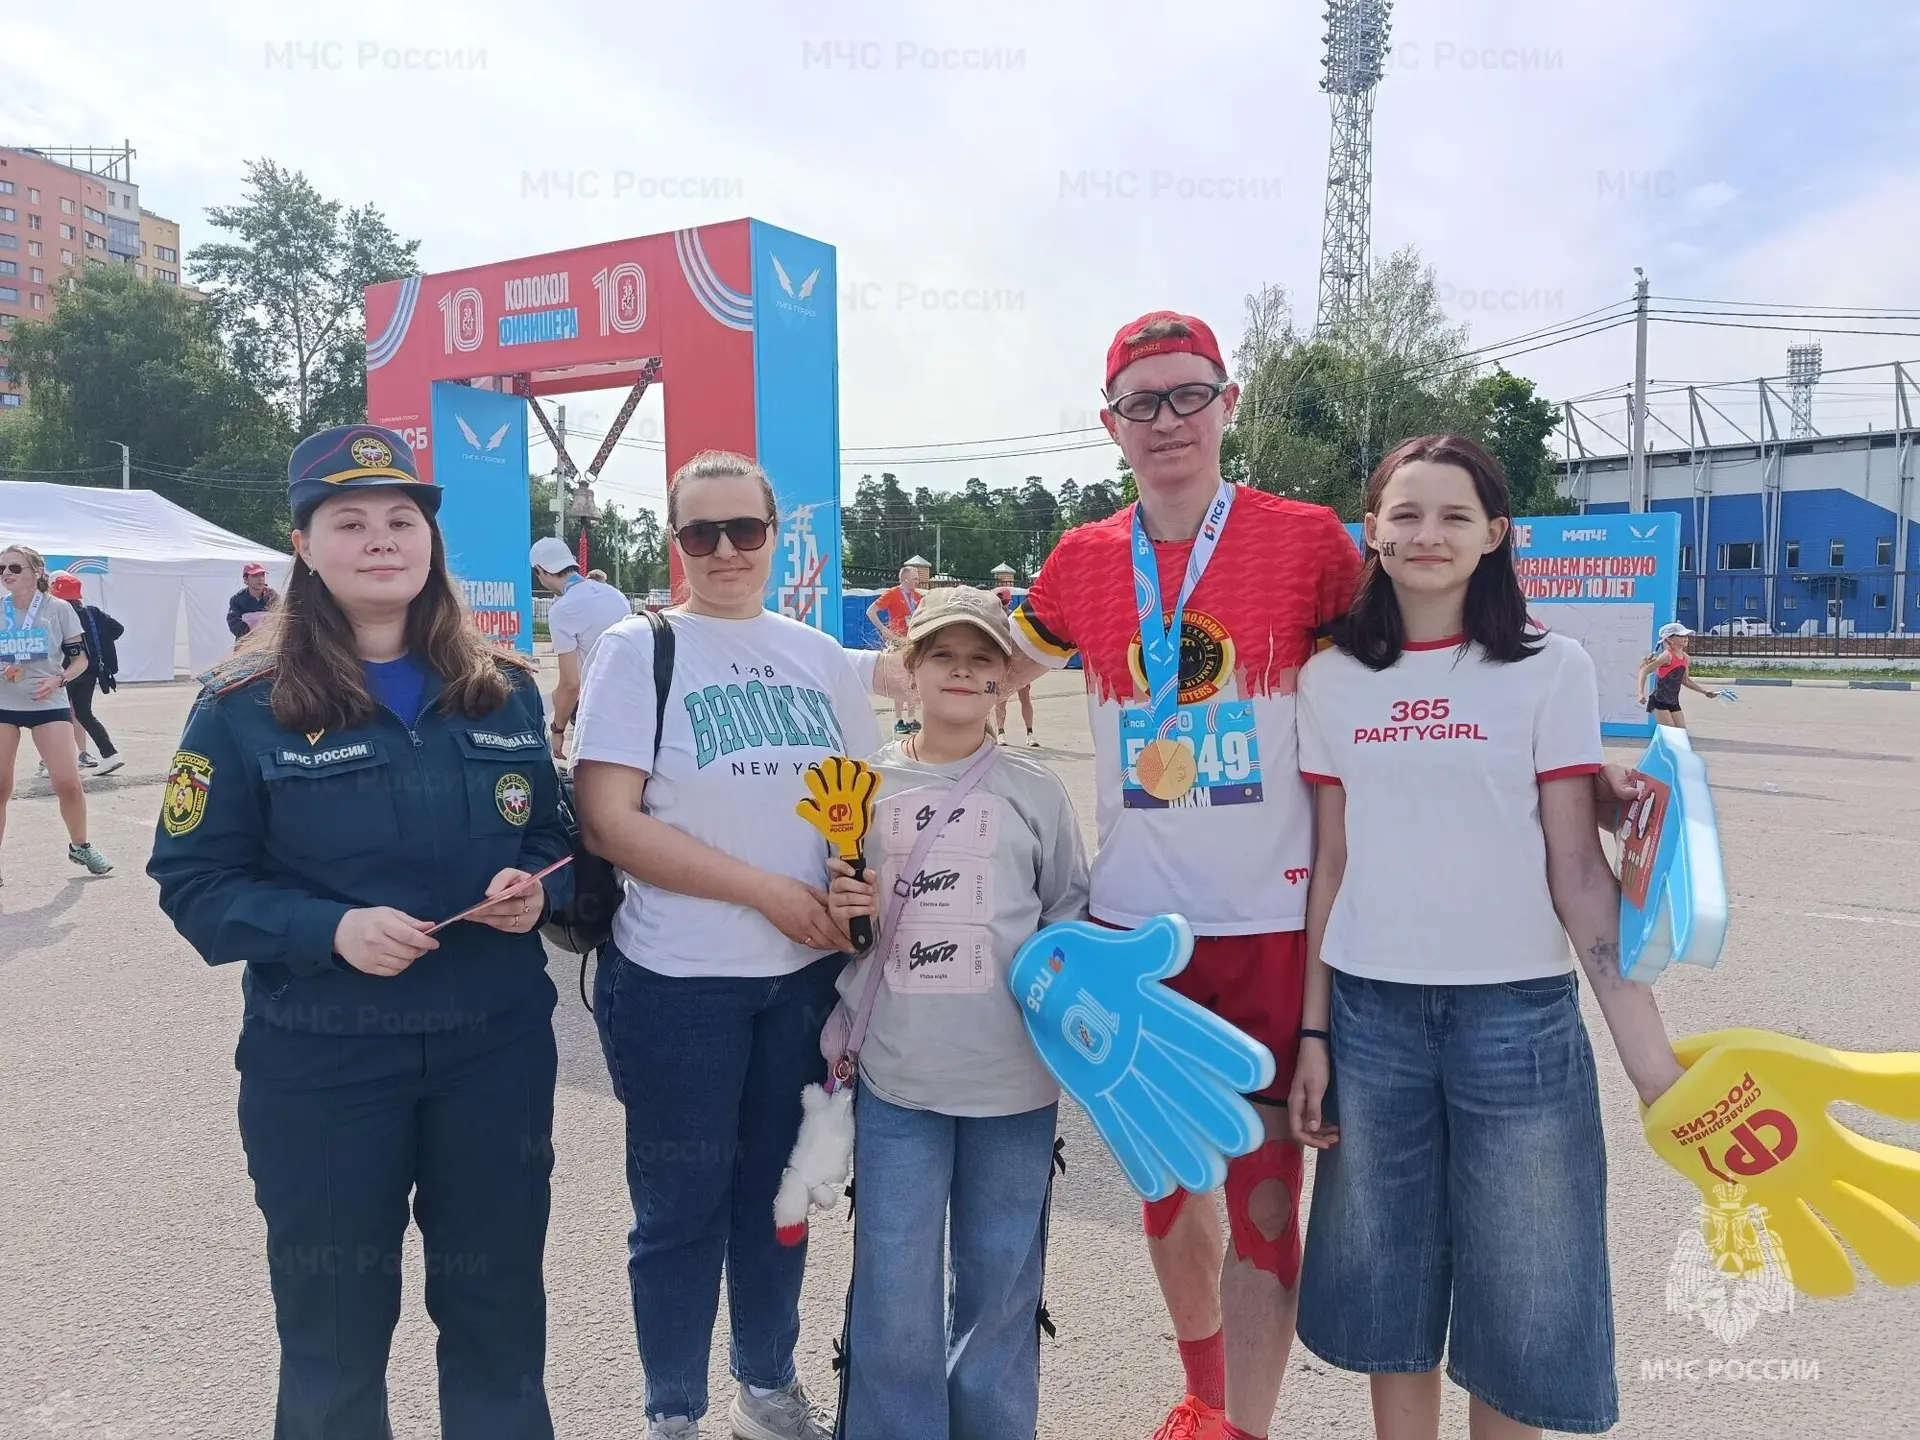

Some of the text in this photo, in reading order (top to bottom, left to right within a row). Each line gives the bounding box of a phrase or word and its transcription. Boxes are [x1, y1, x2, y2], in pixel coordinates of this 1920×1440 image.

[505, 272, 569, 311] КОЛОКОЛ
[592, 262, 646, 337] 10
[438, 287, 484, 355] 10
[500, 308, 578, 345] ФИНИШЕРА
[1209, 499, 1226, 525] ПСБ
[1137, 530, 1149, 556] ПСБ
[1562, 529, 1607, 542] МАТЧ!
[784, 533, 822, 587] ЗА
[1584, 556, 1657, 577] БЕГОВУЮ
[1519, 577, 1635, 599] УЛЬТУРУ 10 ЛЕТ
[472, 611, 520, 636] КОРДЫ
[1182, 611, 1225, 640] MOSCOW
[1390, 698, 1450, 723] 365
[1354, 723, 1489, 744] PARTYGIRL
[282, 744, 368, 765] МЧС РОССИИ
[732, 762, 779, 776] NEW
[1126, 731, 1251, 786] 549
[979, 810, 989, 837] 199119
[975, 875, 983, 905] 199119
[974, 944, 983, 975] 199119
[1026, 967, 1053, 1014] ПСБ
[1671, 1071, 1755, 1140] РОССИЯ
[1679, 1087, 1762, 1146] СПРАВЕДЛИВАЯ
